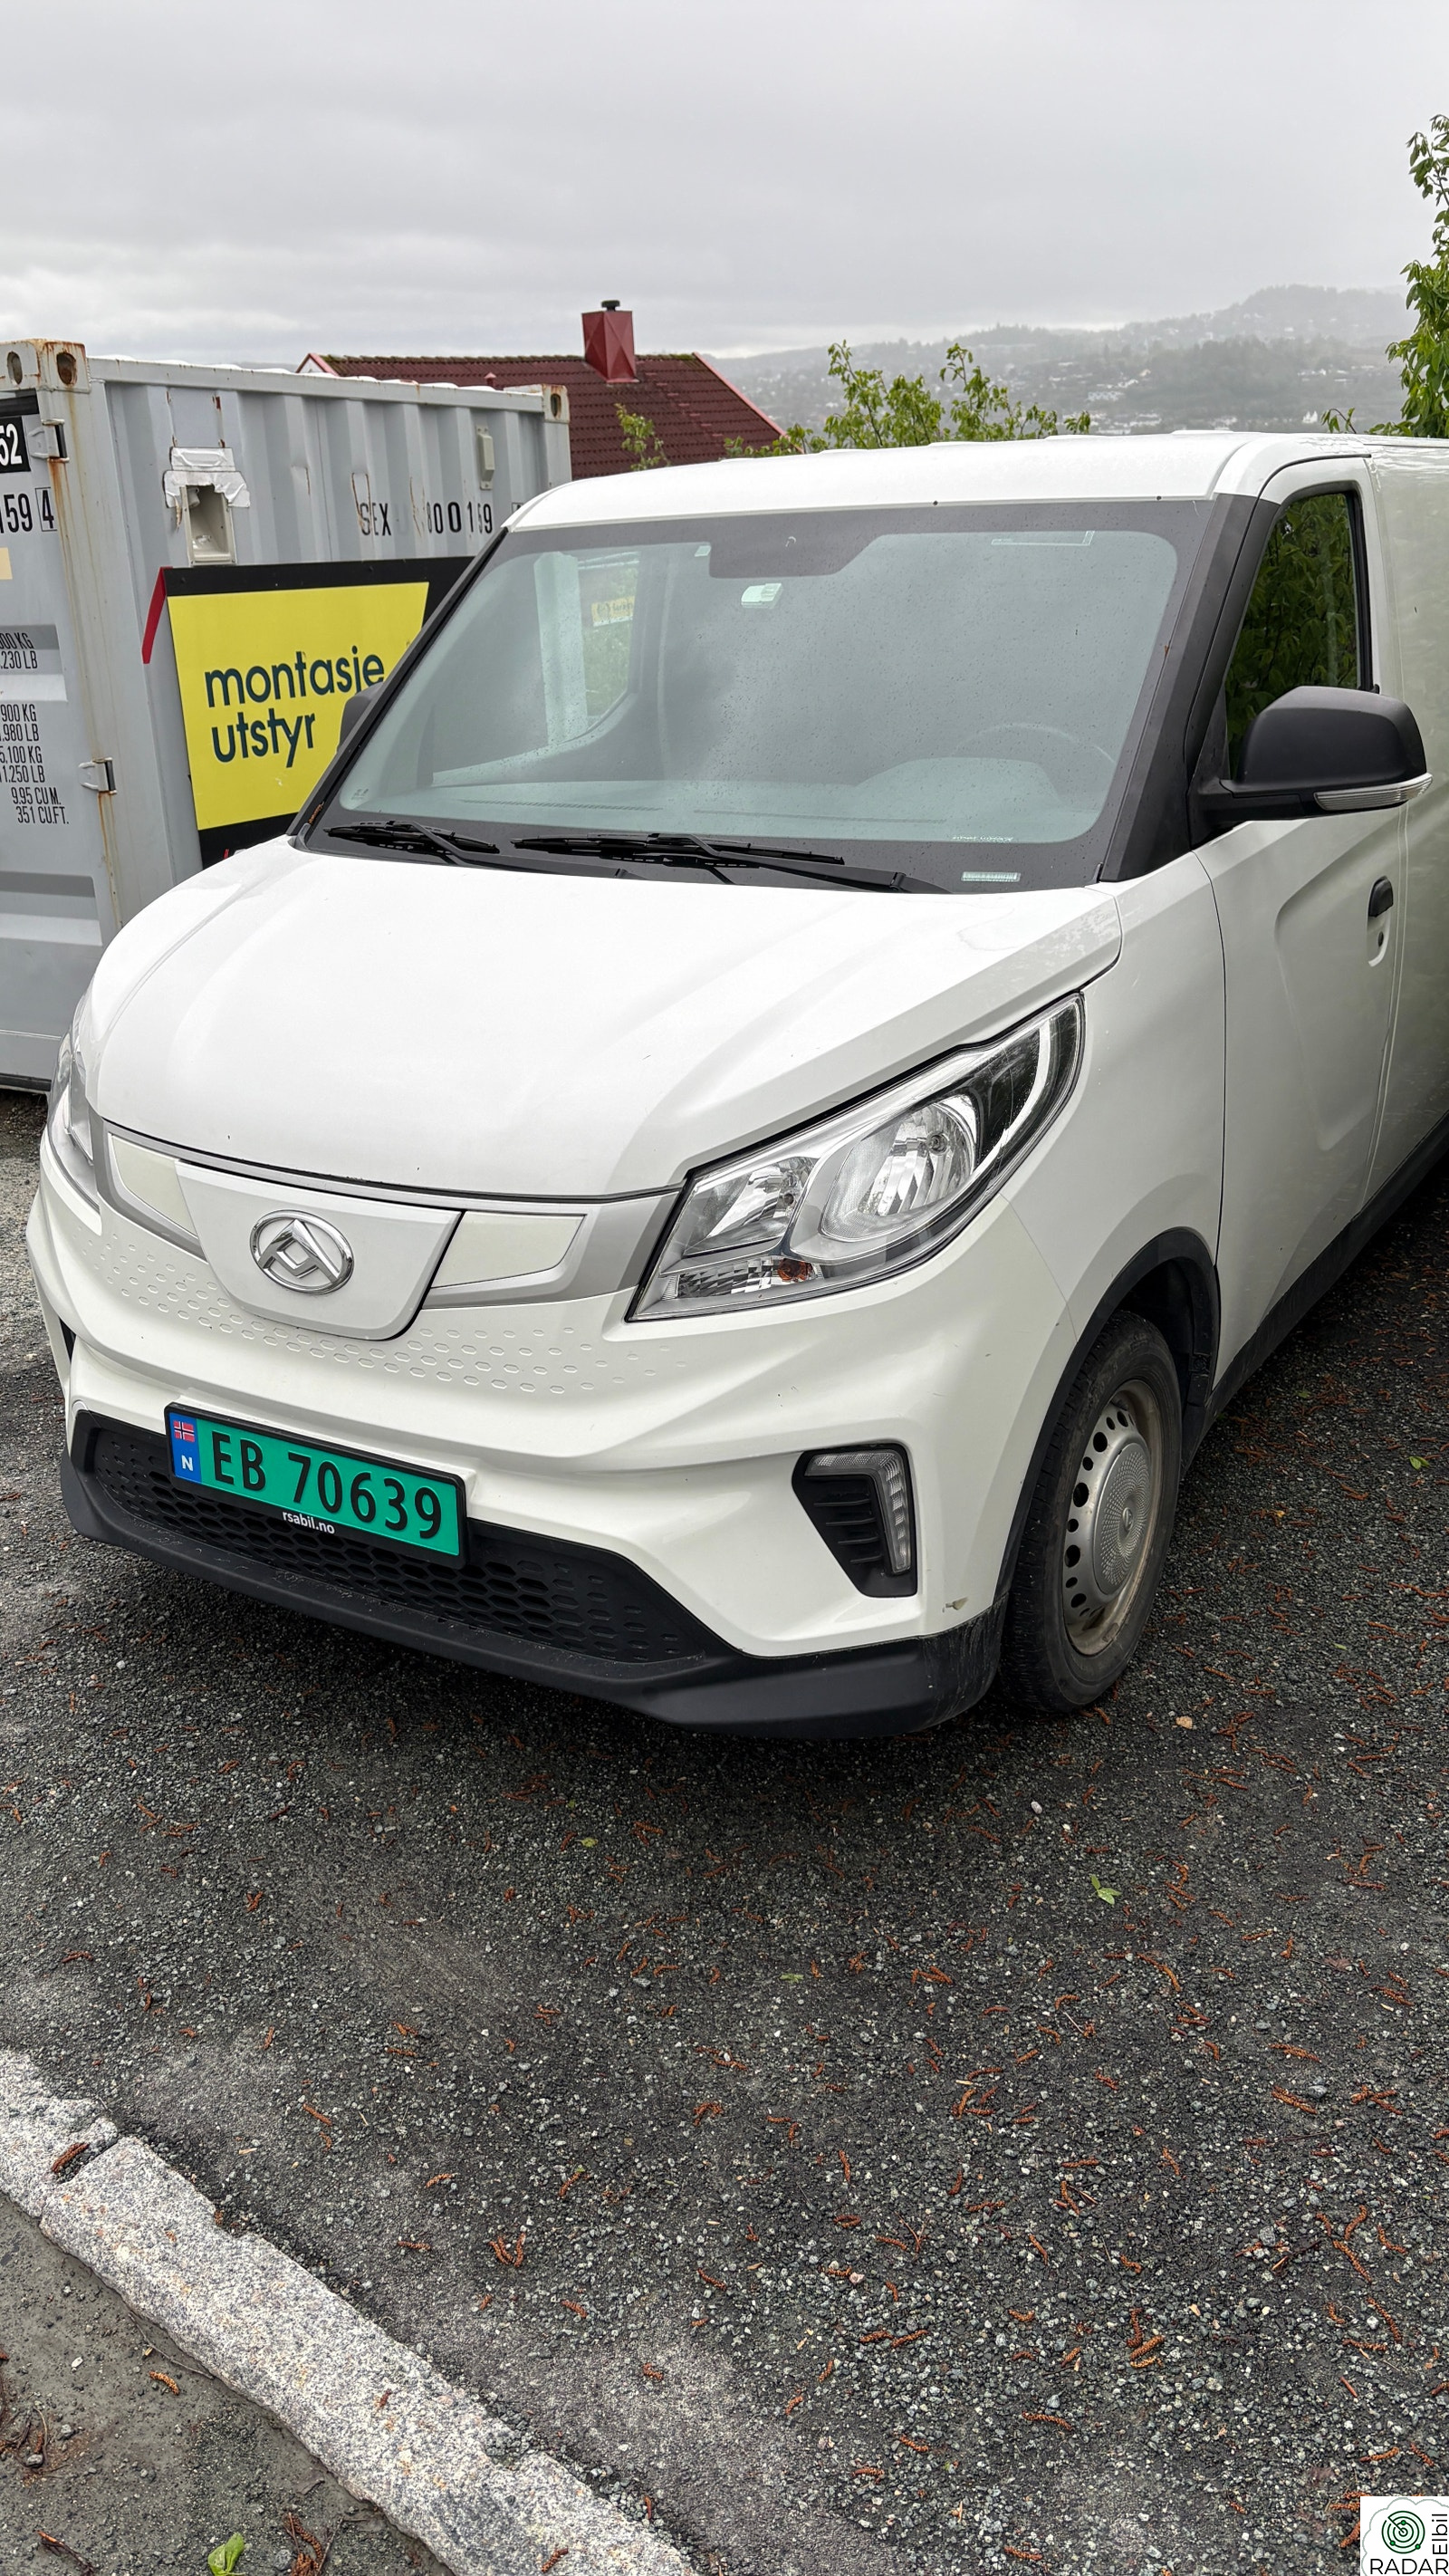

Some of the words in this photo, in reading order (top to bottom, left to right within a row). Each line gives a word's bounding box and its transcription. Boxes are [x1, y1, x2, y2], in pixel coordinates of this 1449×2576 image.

[23, 650, 38, 668] LB
[22, 704, 37, 722] KG
[24, 723, 39, 742] LB
[211, 707, 316, 768] utstyr
[27, 745, 43, 764] KG
[30, 764, 45, 783] LB
[16, 805, 35, 823] 351
[181, 1455, 194, 1472] N
[211, 1430, 267, 1492] EB
[287, 1451, 443, 1540] 70639
[282, 1510, 336, 1535] rsabil.no
